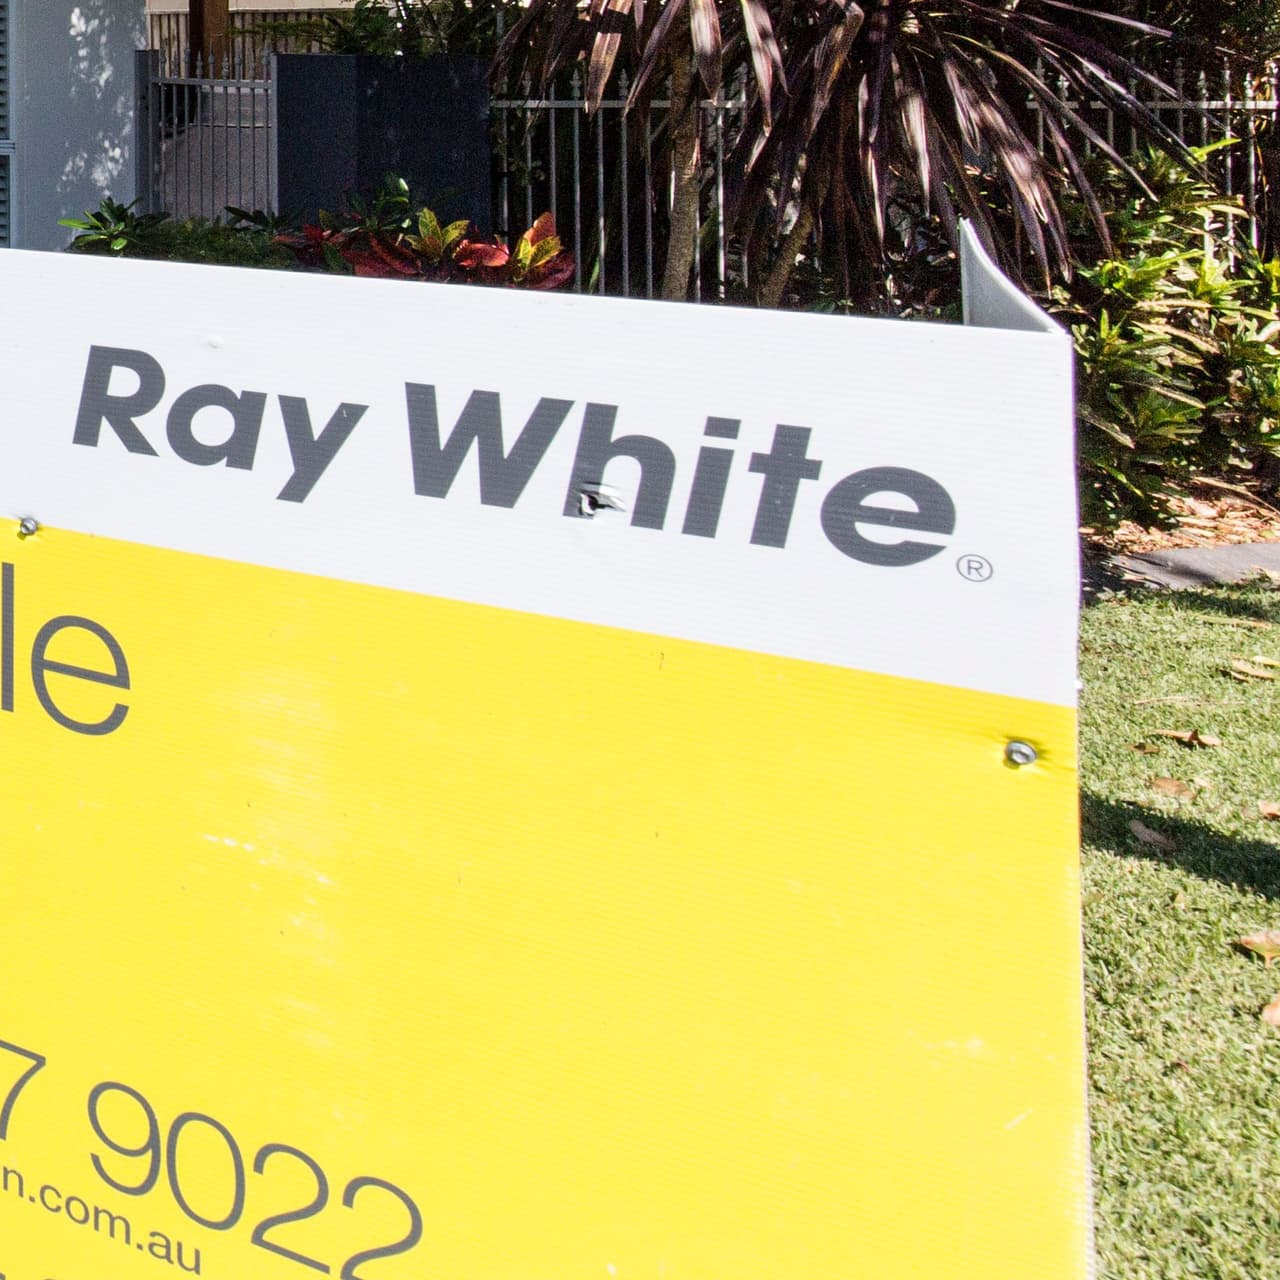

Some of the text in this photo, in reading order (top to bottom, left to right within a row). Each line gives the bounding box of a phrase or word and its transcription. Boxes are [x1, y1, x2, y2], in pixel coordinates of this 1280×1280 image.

[72, 344, 370, 504] Ray
[404, 381, 957, 568] White
[87, 1081, 423, 1280] 9022
